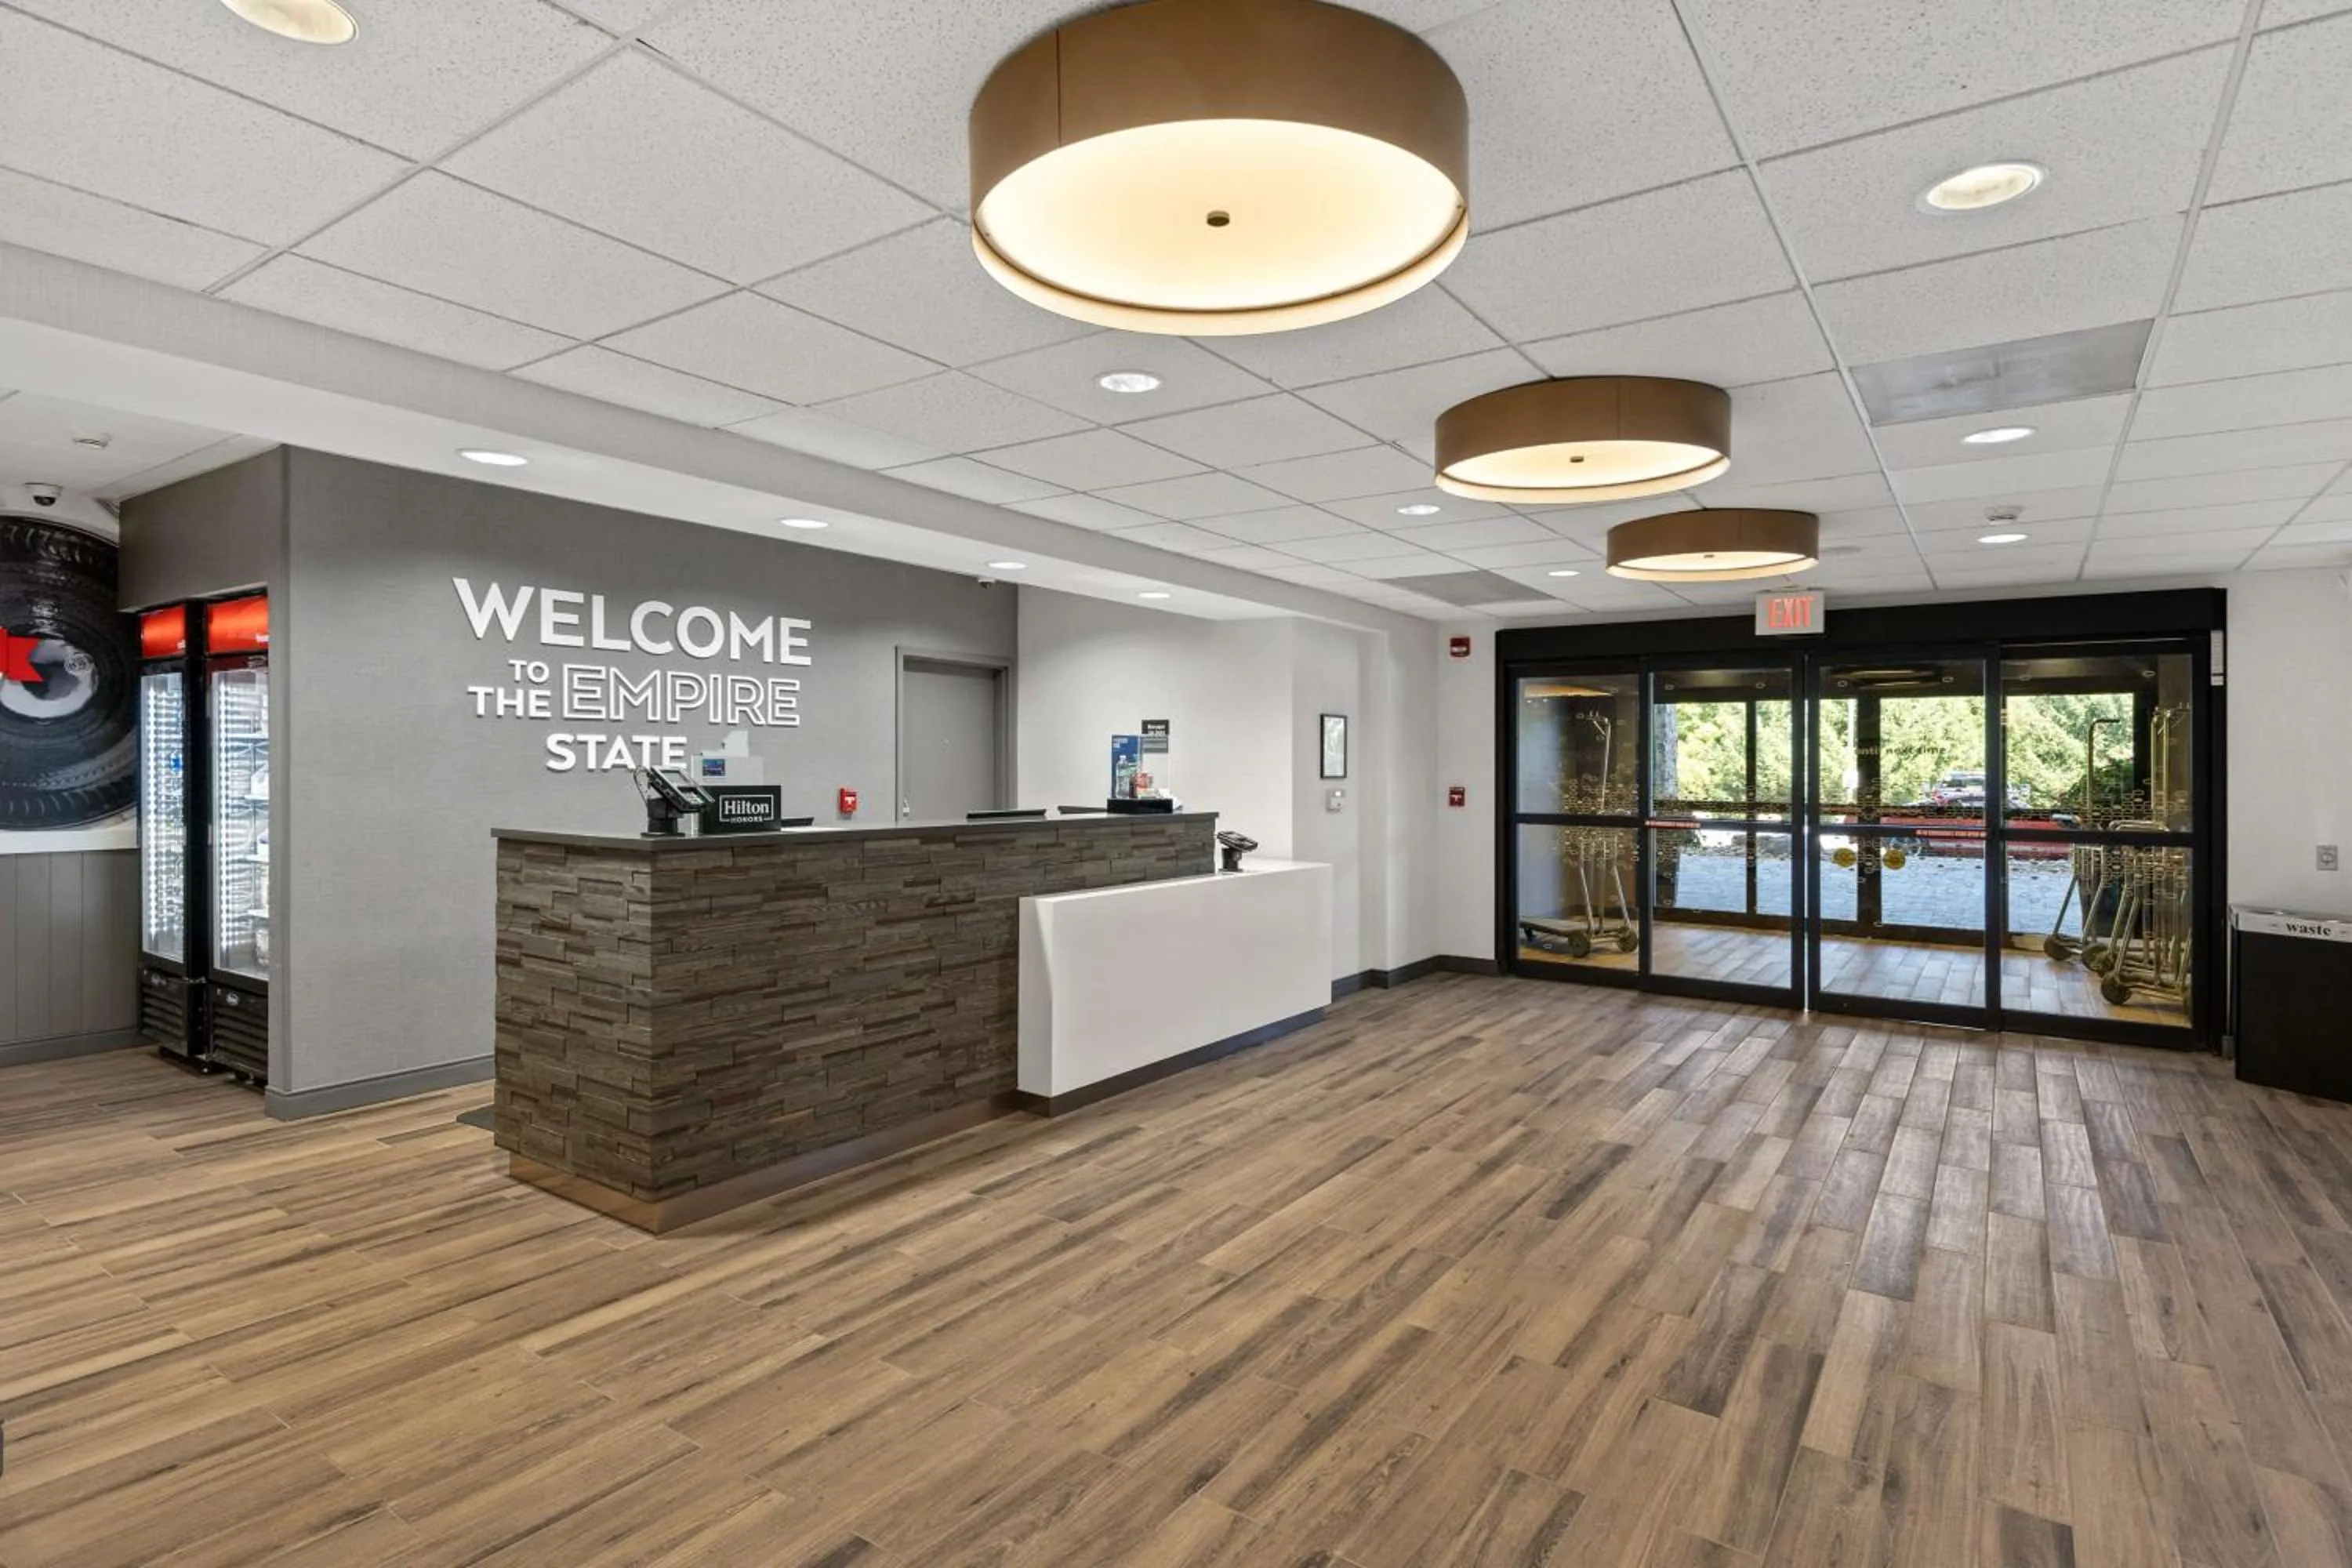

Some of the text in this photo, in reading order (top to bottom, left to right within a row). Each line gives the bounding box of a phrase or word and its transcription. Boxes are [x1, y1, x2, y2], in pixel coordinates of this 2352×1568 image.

[452, 577, 812, 666] WELCOME
[1768, 596, 1814, 628] EXIT
[508, 659, 549, 683] TO
[467, 663, 800, 727] THE EMPIRE
[546, 733, 688, 771] STATE
[724, 800, 769, 815] Hilton
[2286, 923, 2332, 936] waste
